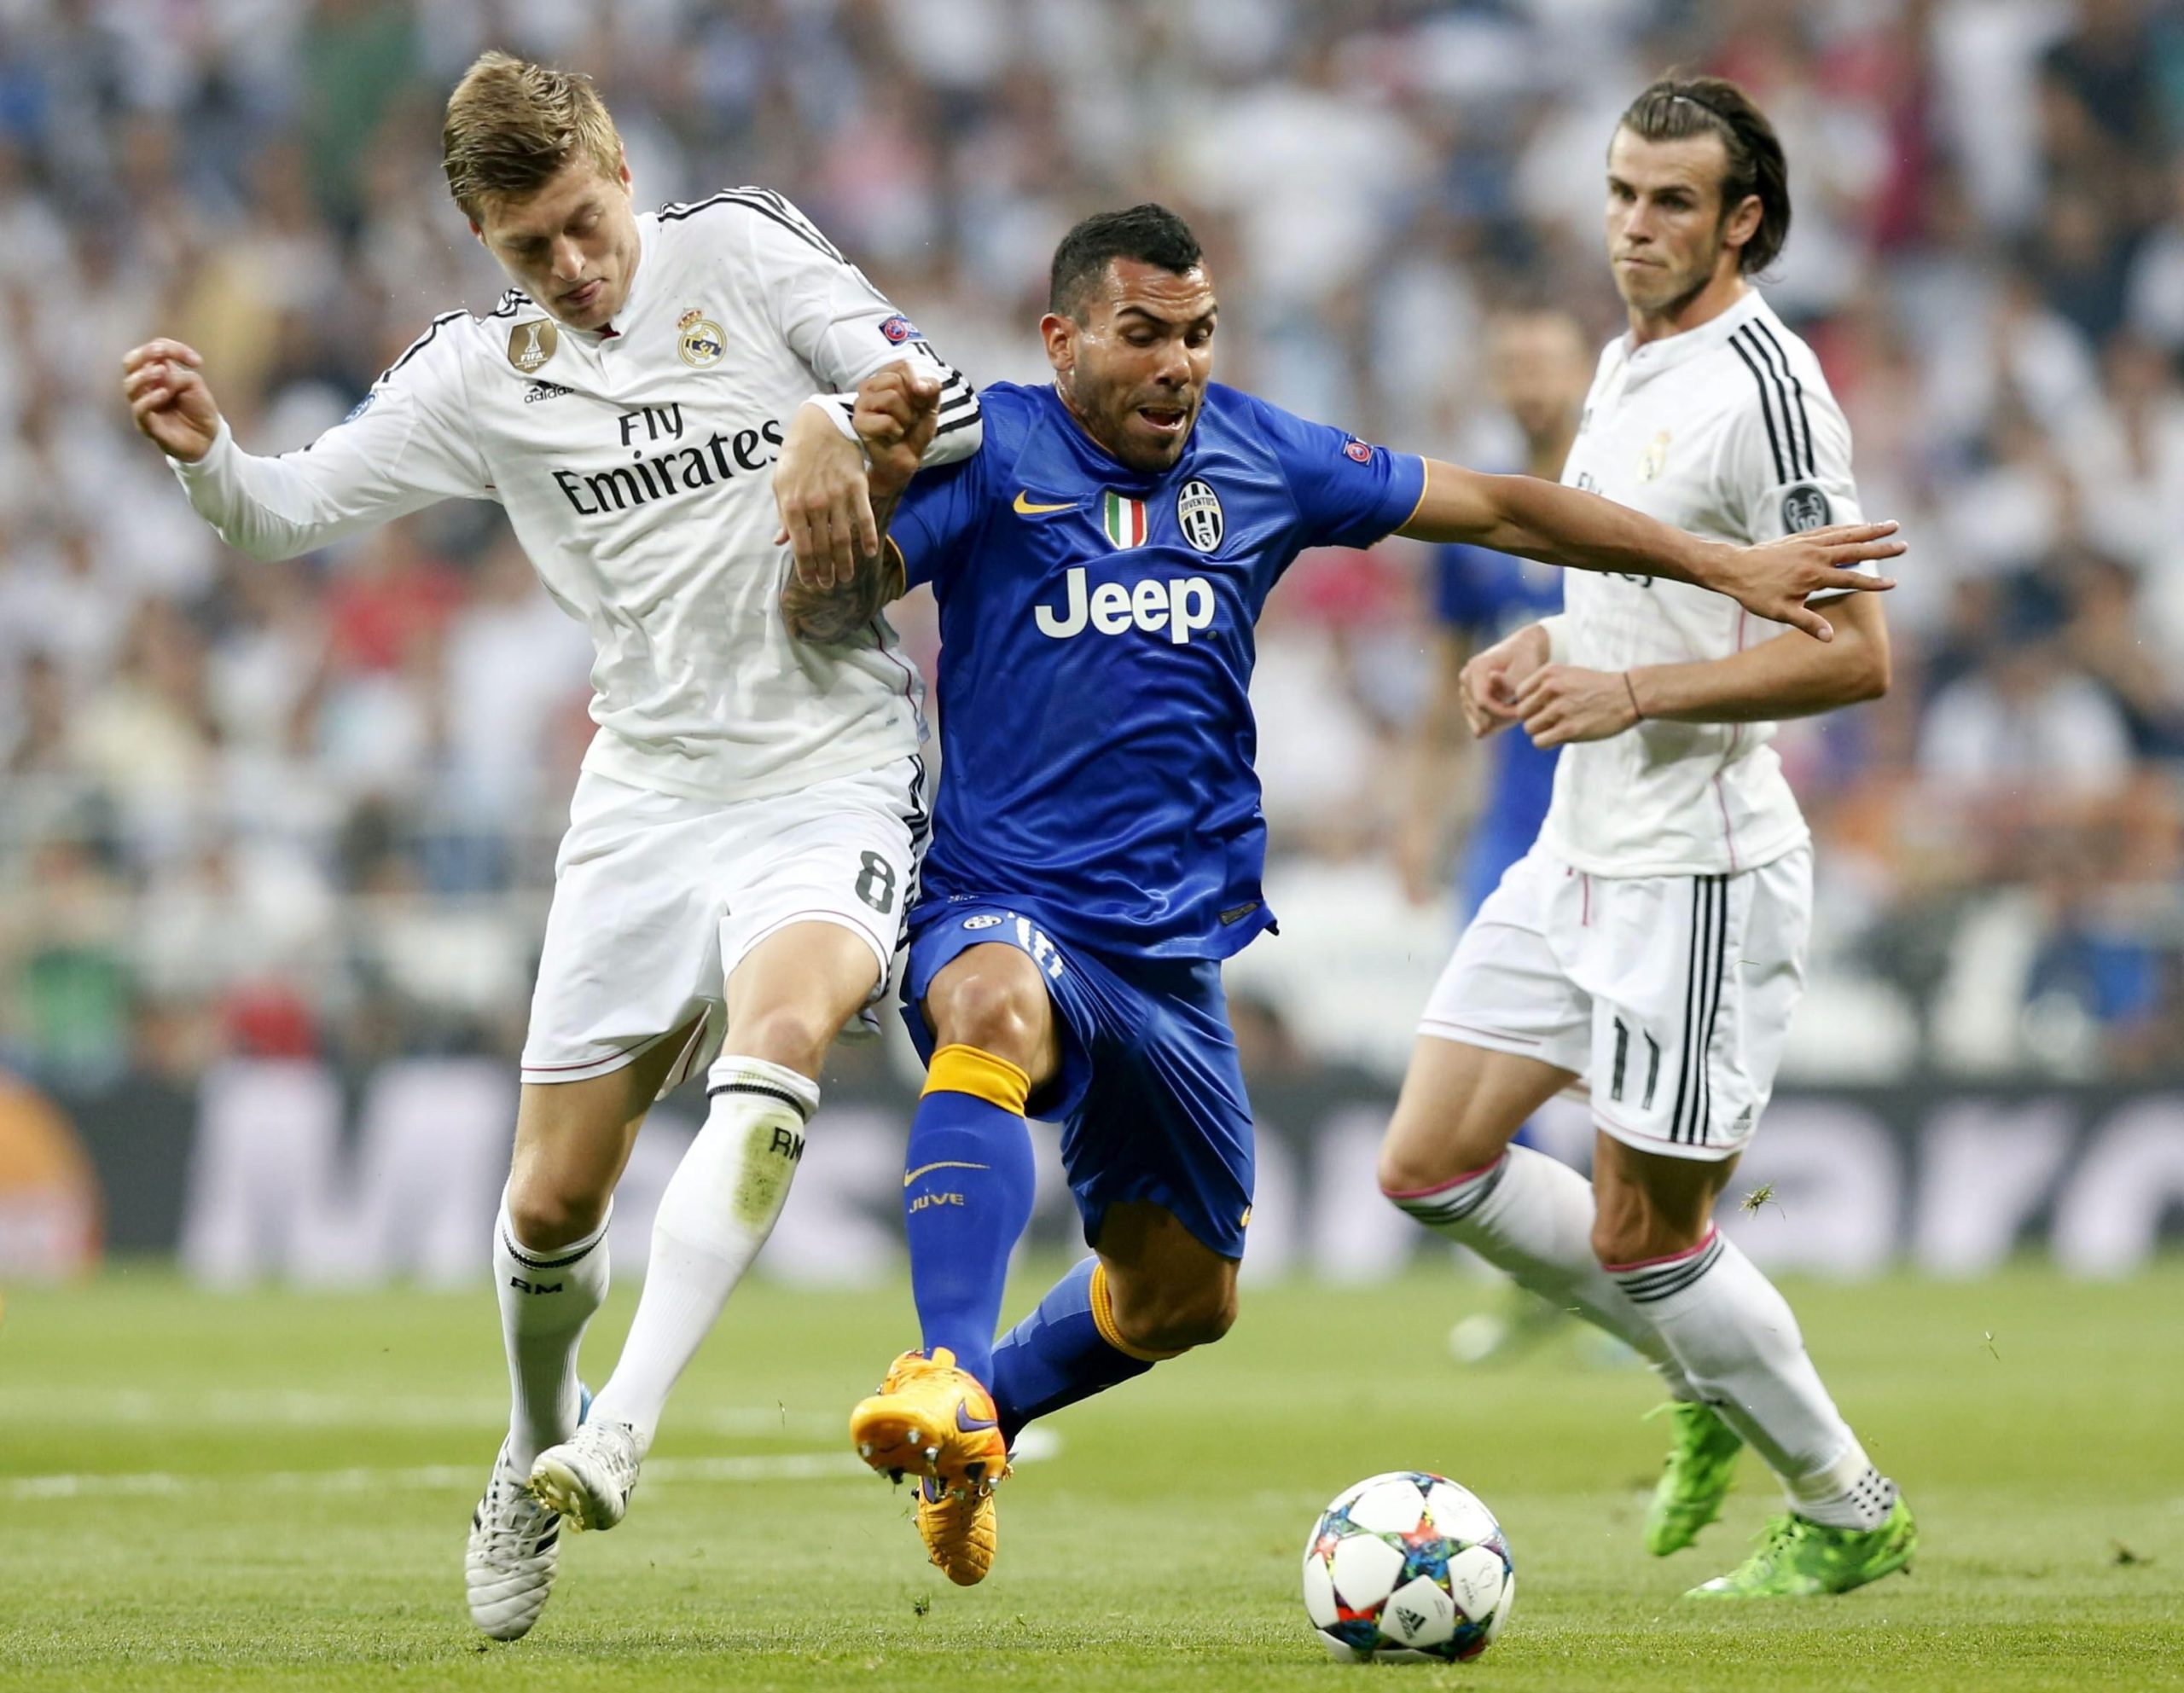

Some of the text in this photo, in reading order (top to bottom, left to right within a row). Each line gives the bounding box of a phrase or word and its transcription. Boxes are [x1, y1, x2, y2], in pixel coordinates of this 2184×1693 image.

[520, 351, 543, 362] FIFA
[524, 385, 574, 403] adidas
[618, 403, 683, 446] Fly
[552, 420, 784, 515] Emirates
[1181, 497, 1217, 512] JUVENTUS
[1035, 567, 1215, 644] Jeep
[855, 850, 895, 914] 8
[1612, 1016, 1660, 1110] 11
[770, 1127, 805, 1164] RM
[909, 1192, 964, 1214] JUVE
[510, 1277, 563, 1295] RM
